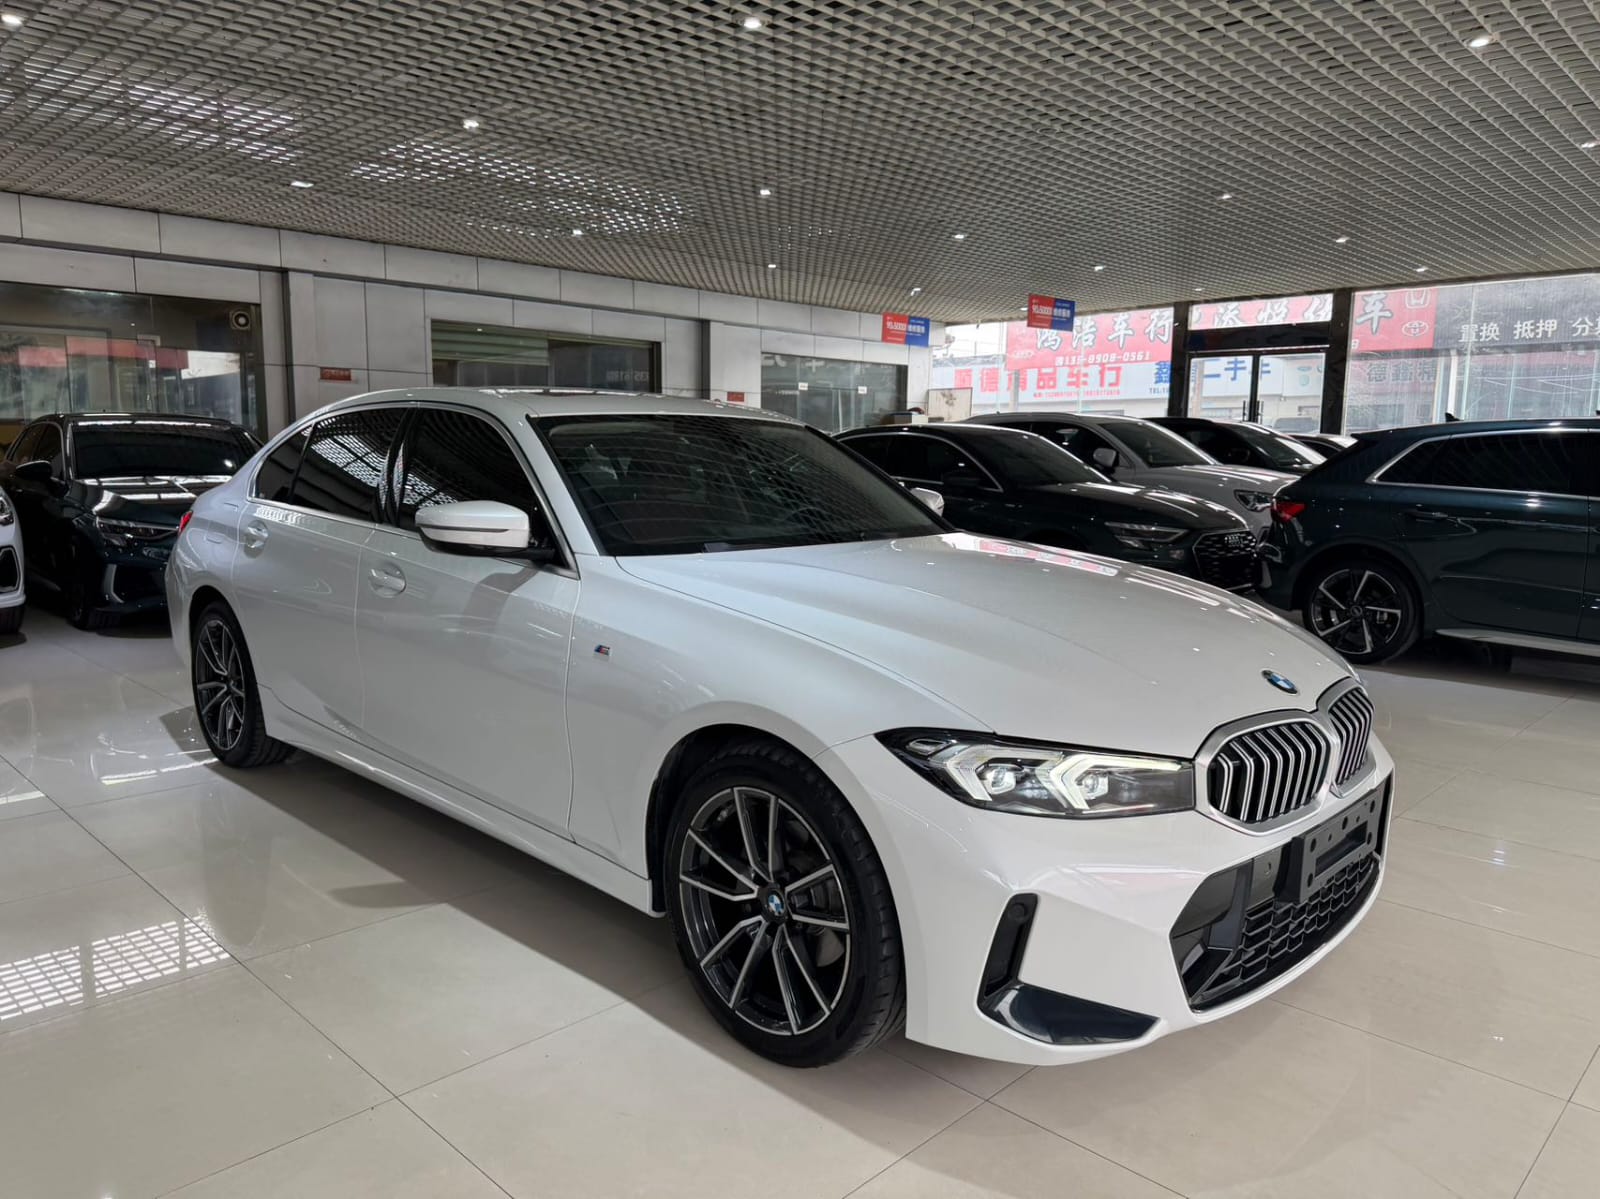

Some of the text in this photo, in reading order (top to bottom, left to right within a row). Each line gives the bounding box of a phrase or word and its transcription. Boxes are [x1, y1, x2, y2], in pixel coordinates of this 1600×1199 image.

[1458, 315, 1600, 342] 置换 抵押 分
